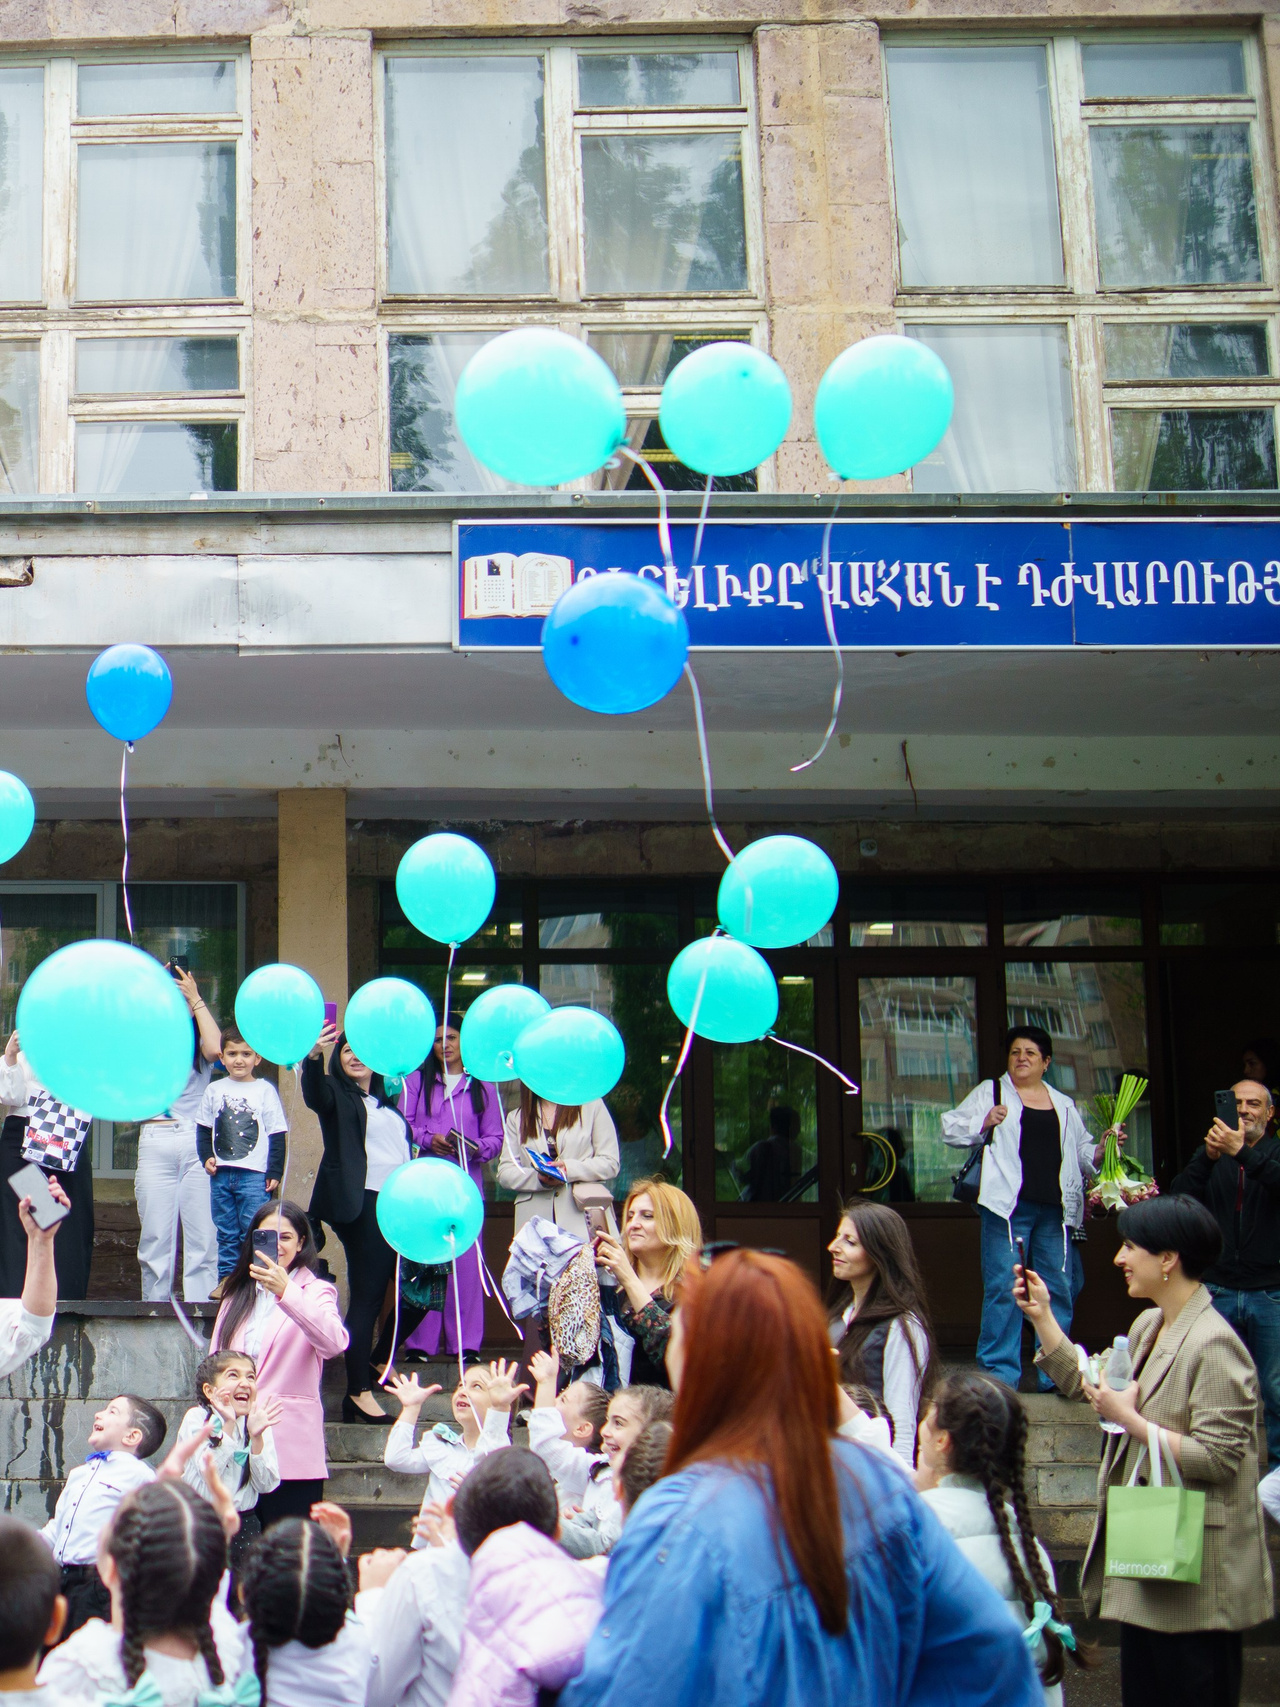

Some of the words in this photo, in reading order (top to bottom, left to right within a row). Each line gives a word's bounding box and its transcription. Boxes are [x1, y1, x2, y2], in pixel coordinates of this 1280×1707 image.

[577, 561, 804, 611] ԵԼԻՔԸ
[975, 563, 1003, 611] Է
[1109, 1559, 1169, 1576] Hermosa
